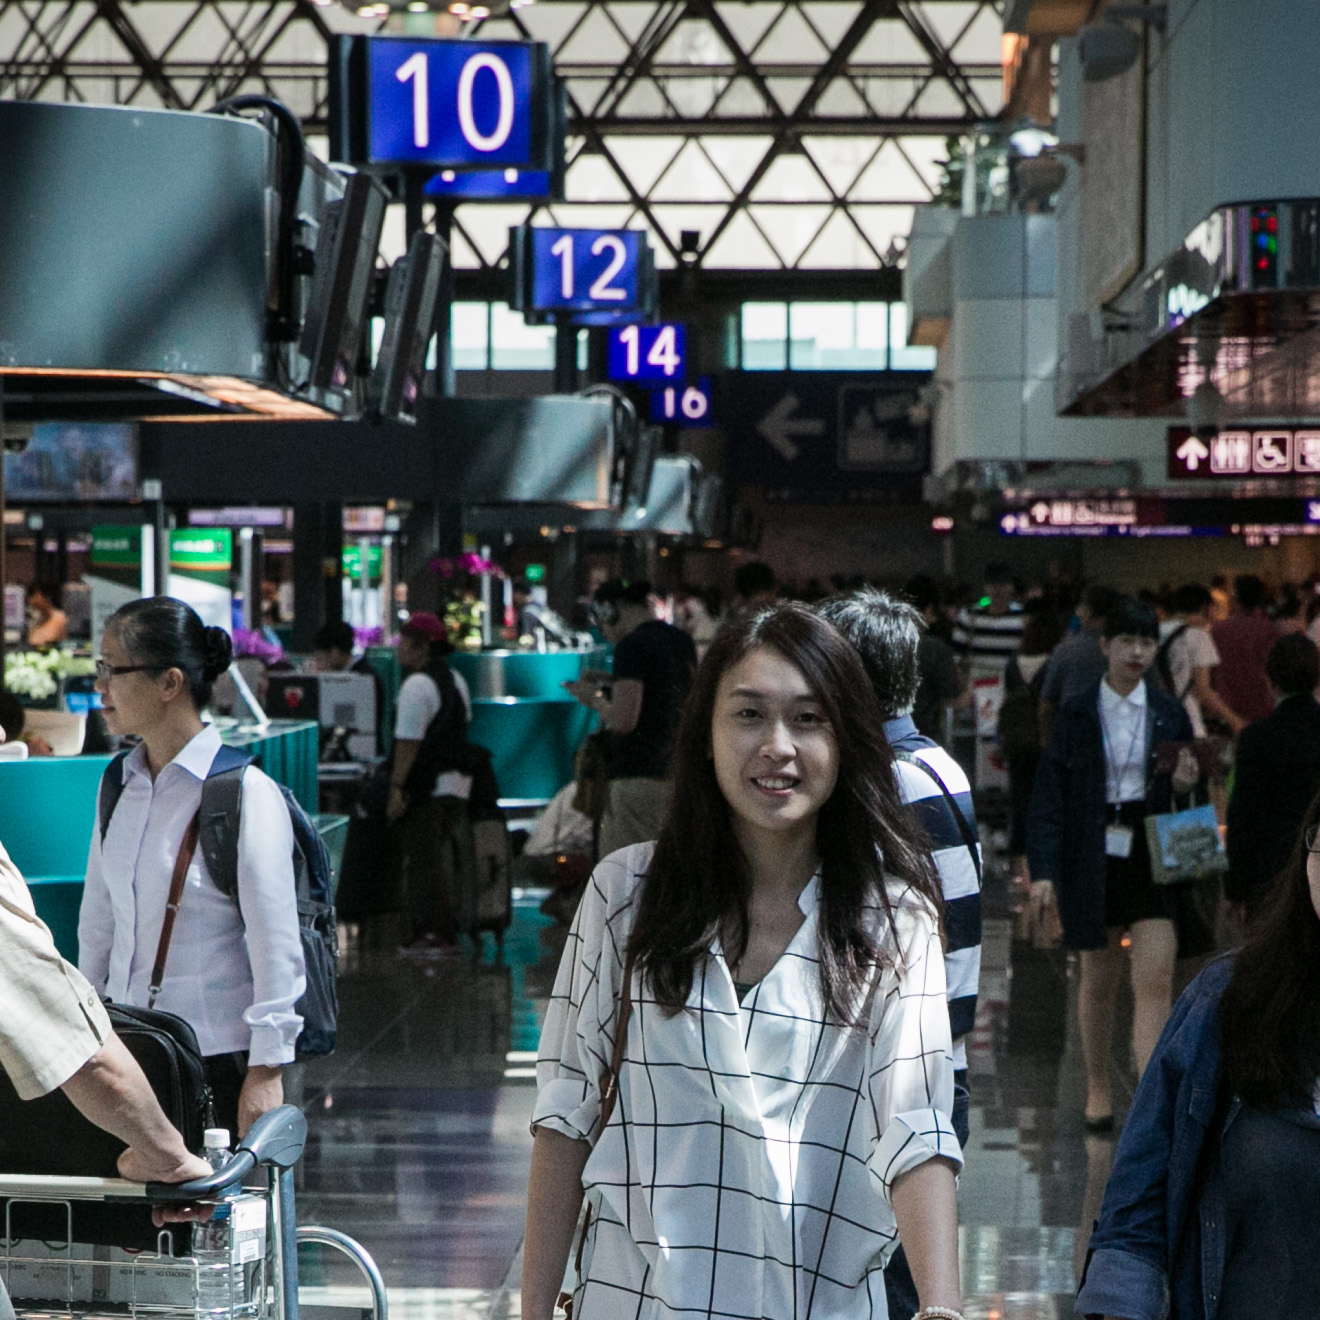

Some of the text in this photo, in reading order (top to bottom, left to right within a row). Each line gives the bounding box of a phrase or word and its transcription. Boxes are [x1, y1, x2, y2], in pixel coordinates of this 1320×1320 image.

[395, 51, 515, 152] 10
[550, 234, 628, 301] 12
[617, 326, 680, 376] 14
[663, 390, 708, 419] 16
